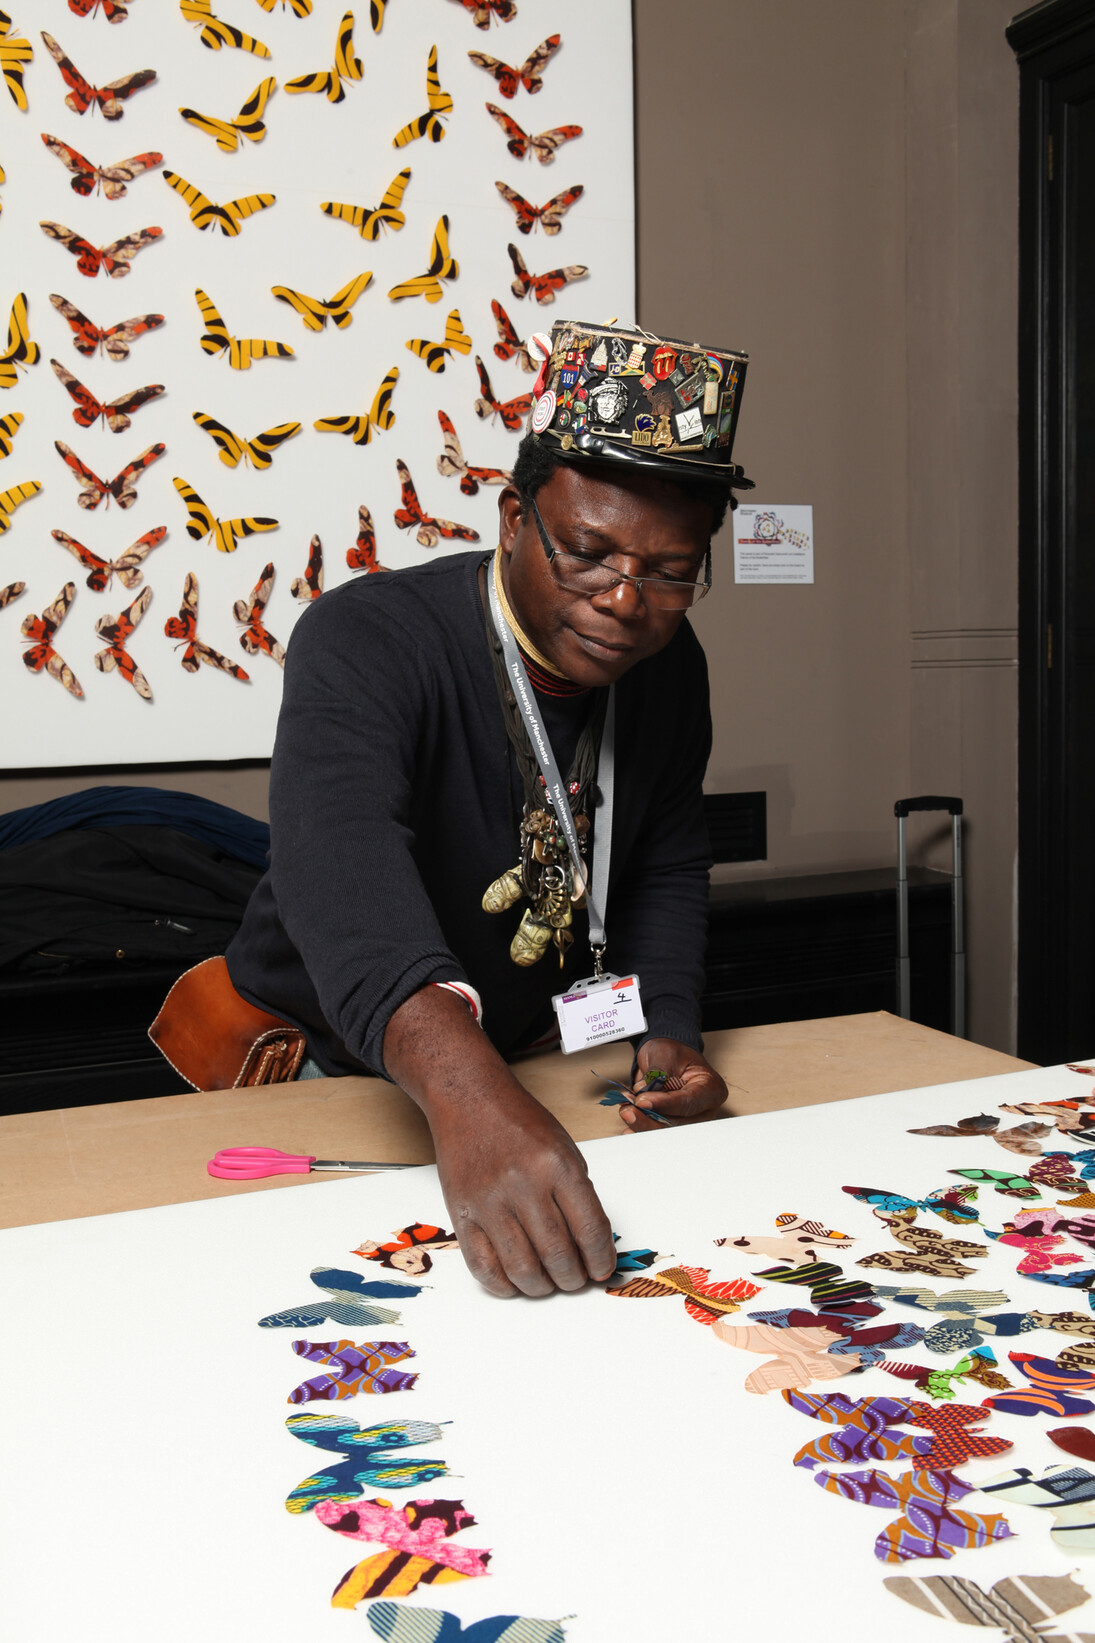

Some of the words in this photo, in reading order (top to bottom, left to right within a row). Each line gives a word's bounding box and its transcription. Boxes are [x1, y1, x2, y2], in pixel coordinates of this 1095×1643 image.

[562, 372, 574, 384] 101
[511, 662, 520, 677] The
[516, 677, 533, 715] University
[528, 715, 538, 724] of
[532, 723, 550, 766] Manchester
[552, 784, 561, 799] The
[558, 798, 572, 835] University
[618, 992, 626, 1001] 4
[584, 1009, 618, 1024] VISITOR
[592, 1020, 616, 1032] CARD
